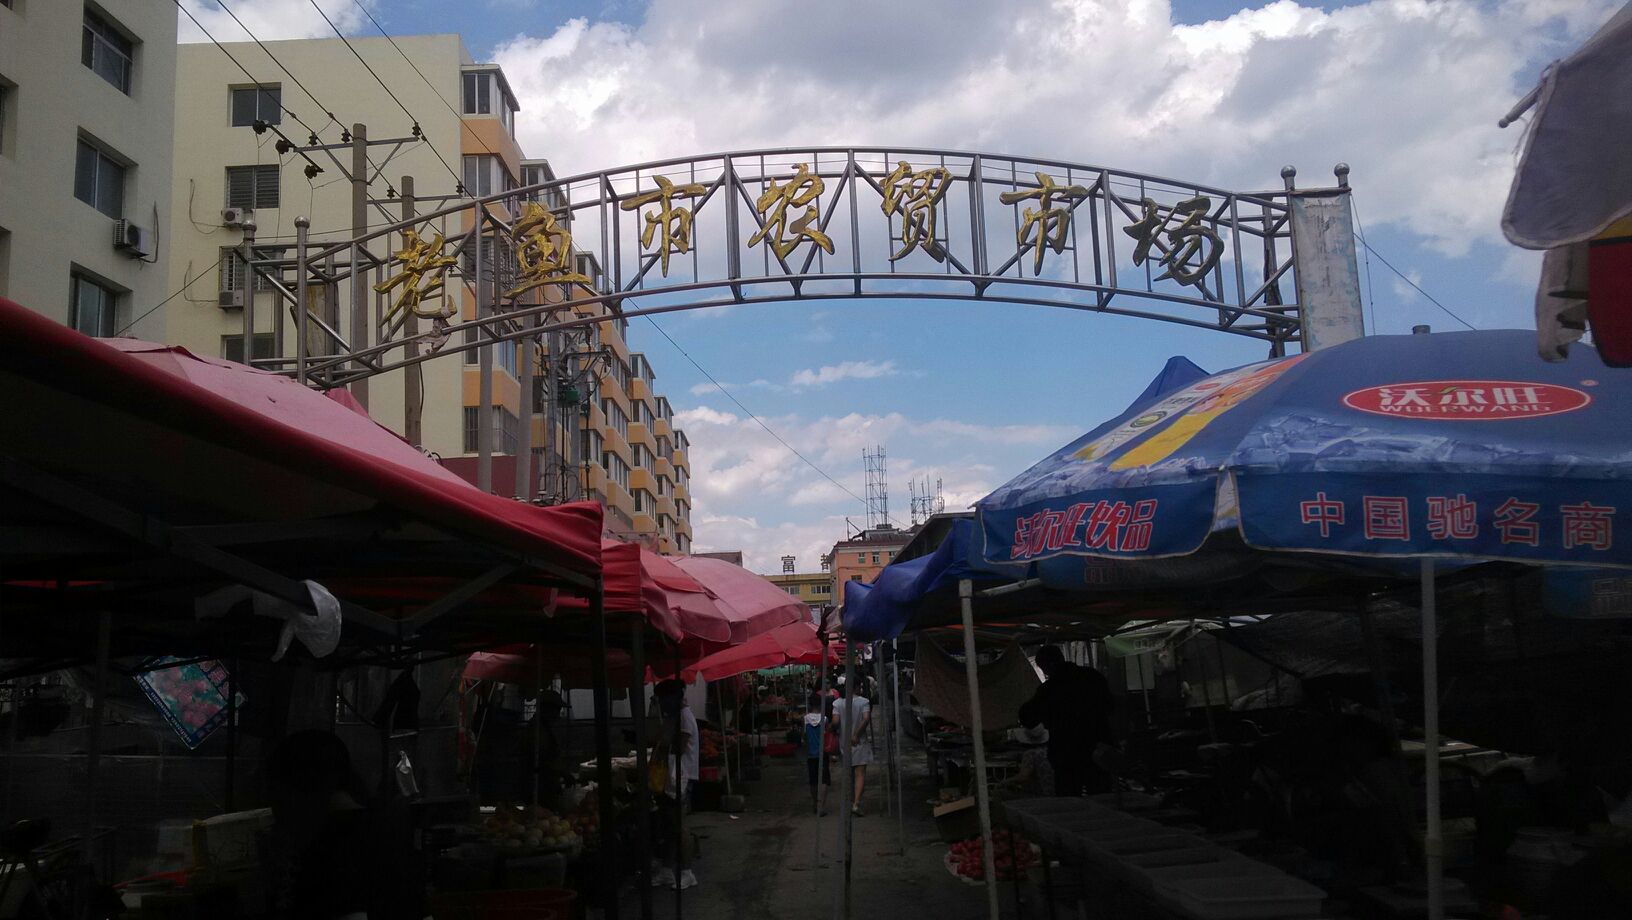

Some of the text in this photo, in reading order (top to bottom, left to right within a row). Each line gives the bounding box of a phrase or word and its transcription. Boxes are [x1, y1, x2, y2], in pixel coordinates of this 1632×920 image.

[1379, 387, 1553, 406] 沃尔旺
[1300, 492, 1617, 551] 中国驰名商
